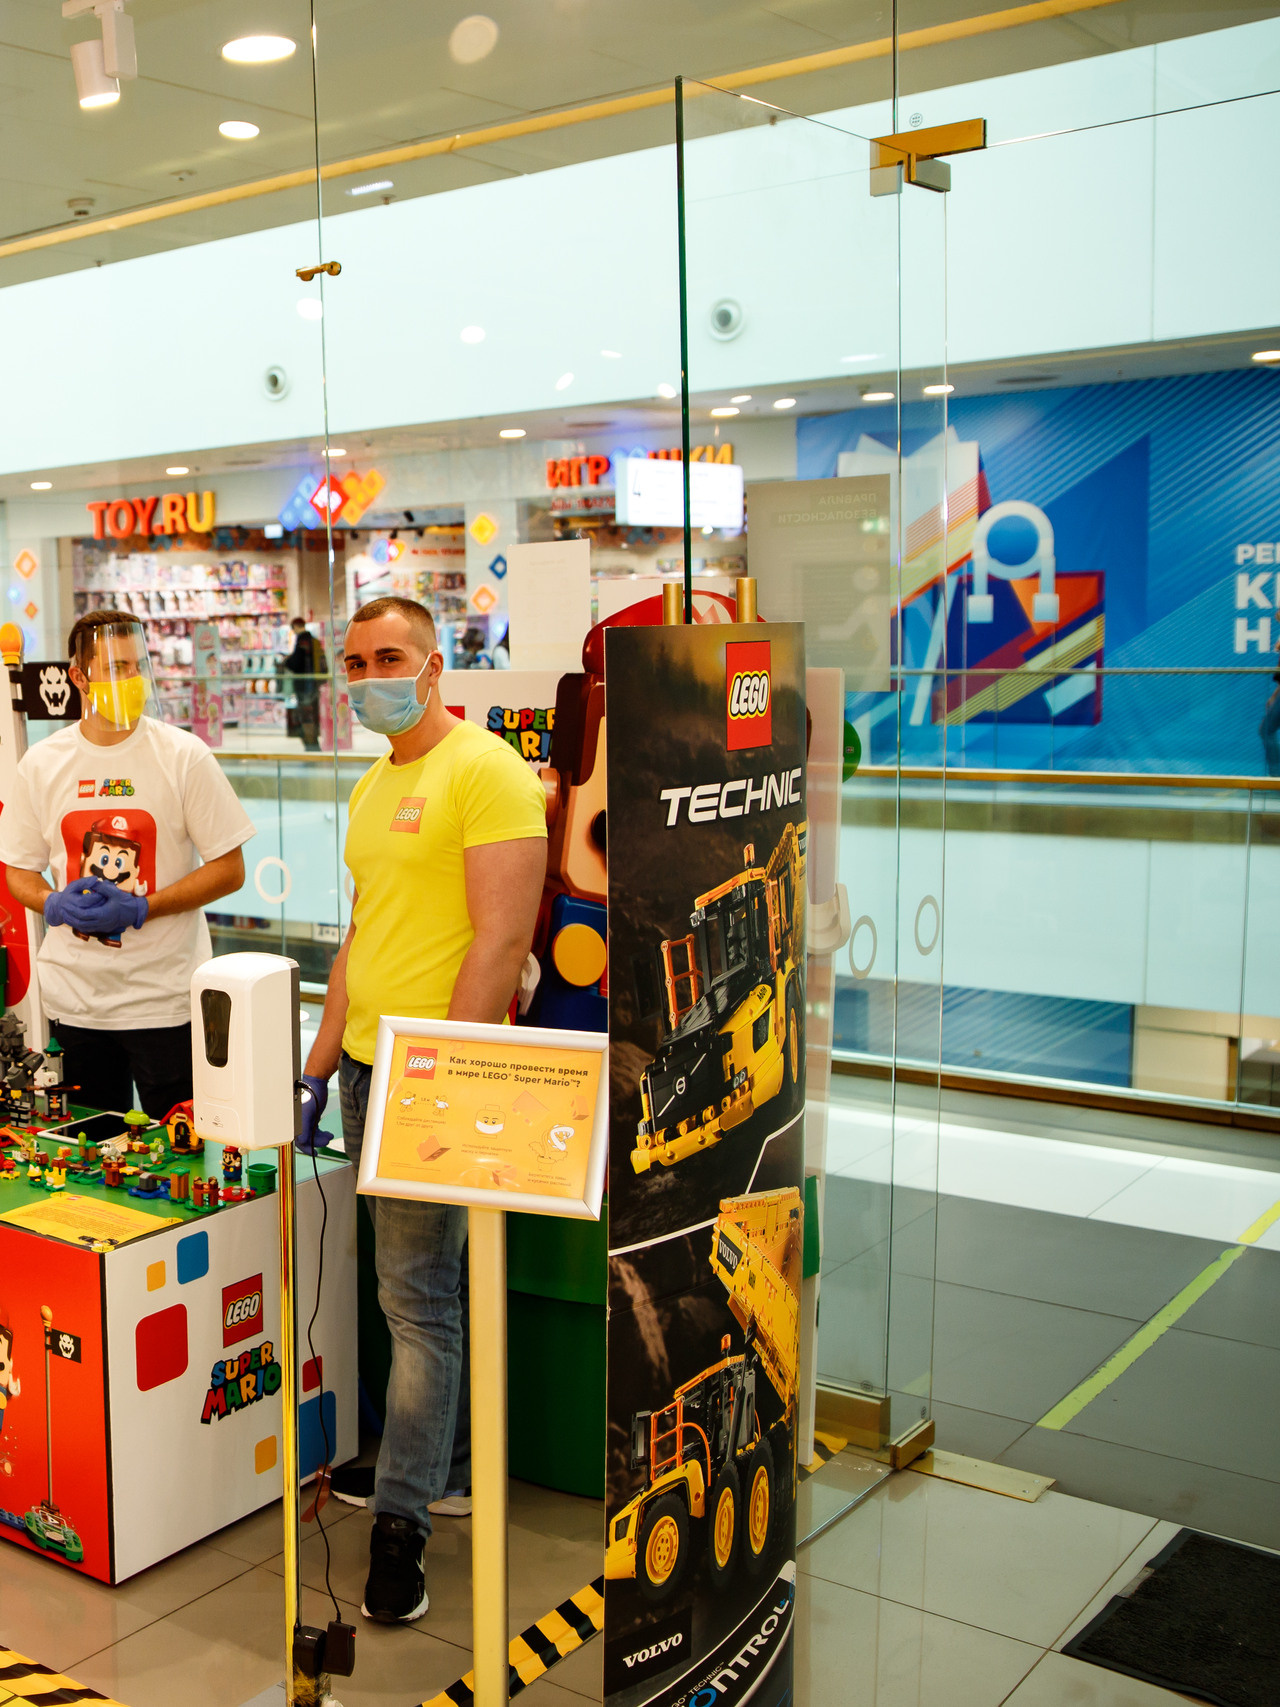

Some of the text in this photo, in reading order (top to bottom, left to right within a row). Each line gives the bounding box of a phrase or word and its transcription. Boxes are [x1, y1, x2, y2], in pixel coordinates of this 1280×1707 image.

[86, 491, 216, 540] TOY.RU
[728, 671, 770, 718] LEGO
[492, 729, 553, 763] ARI
[98, 786, 135, 797] MARIO
[103, 779, 131, 787] SUPER
[660, 767, 802, 827] TECHNIC
[395, 807, 421, 822] LEGO
[407, 1056, 435, 1070] LEGO
[449, 1056, 589, 1077] Как хорошо провести время
[455, 1070, 480, 1078] мире
[514, 1074, 541, 1084] Super
[719, 1238, 738, 1270] VOLVO
[224, 1292, 261, 1329] LEGO
[210, 1340, 274, 1388] SUPER
[200, 1361, 282, 1425] MARIO
[622, 1632, 684, 1669] VOLVO
